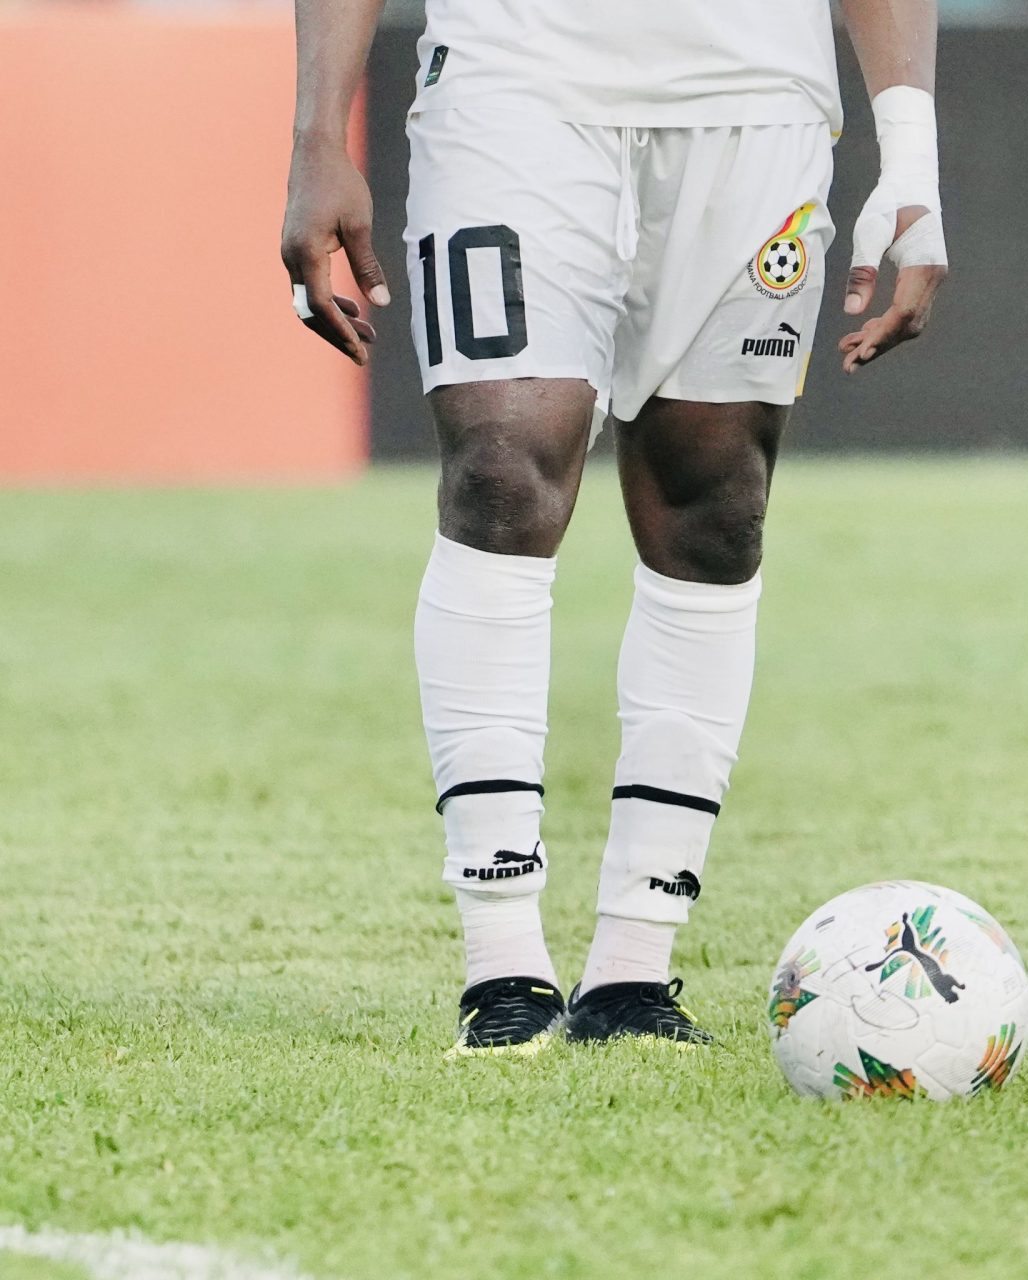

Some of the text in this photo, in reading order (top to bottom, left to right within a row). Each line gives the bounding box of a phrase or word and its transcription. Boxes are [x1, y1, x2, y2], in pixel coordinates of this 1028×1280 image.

[419, 224, 528, 367] 10
[753, 282, 785, 300] FOOTBALL
[741, 338, 796, 358] PUMA
[463, 862, 535, 881] PUMA
